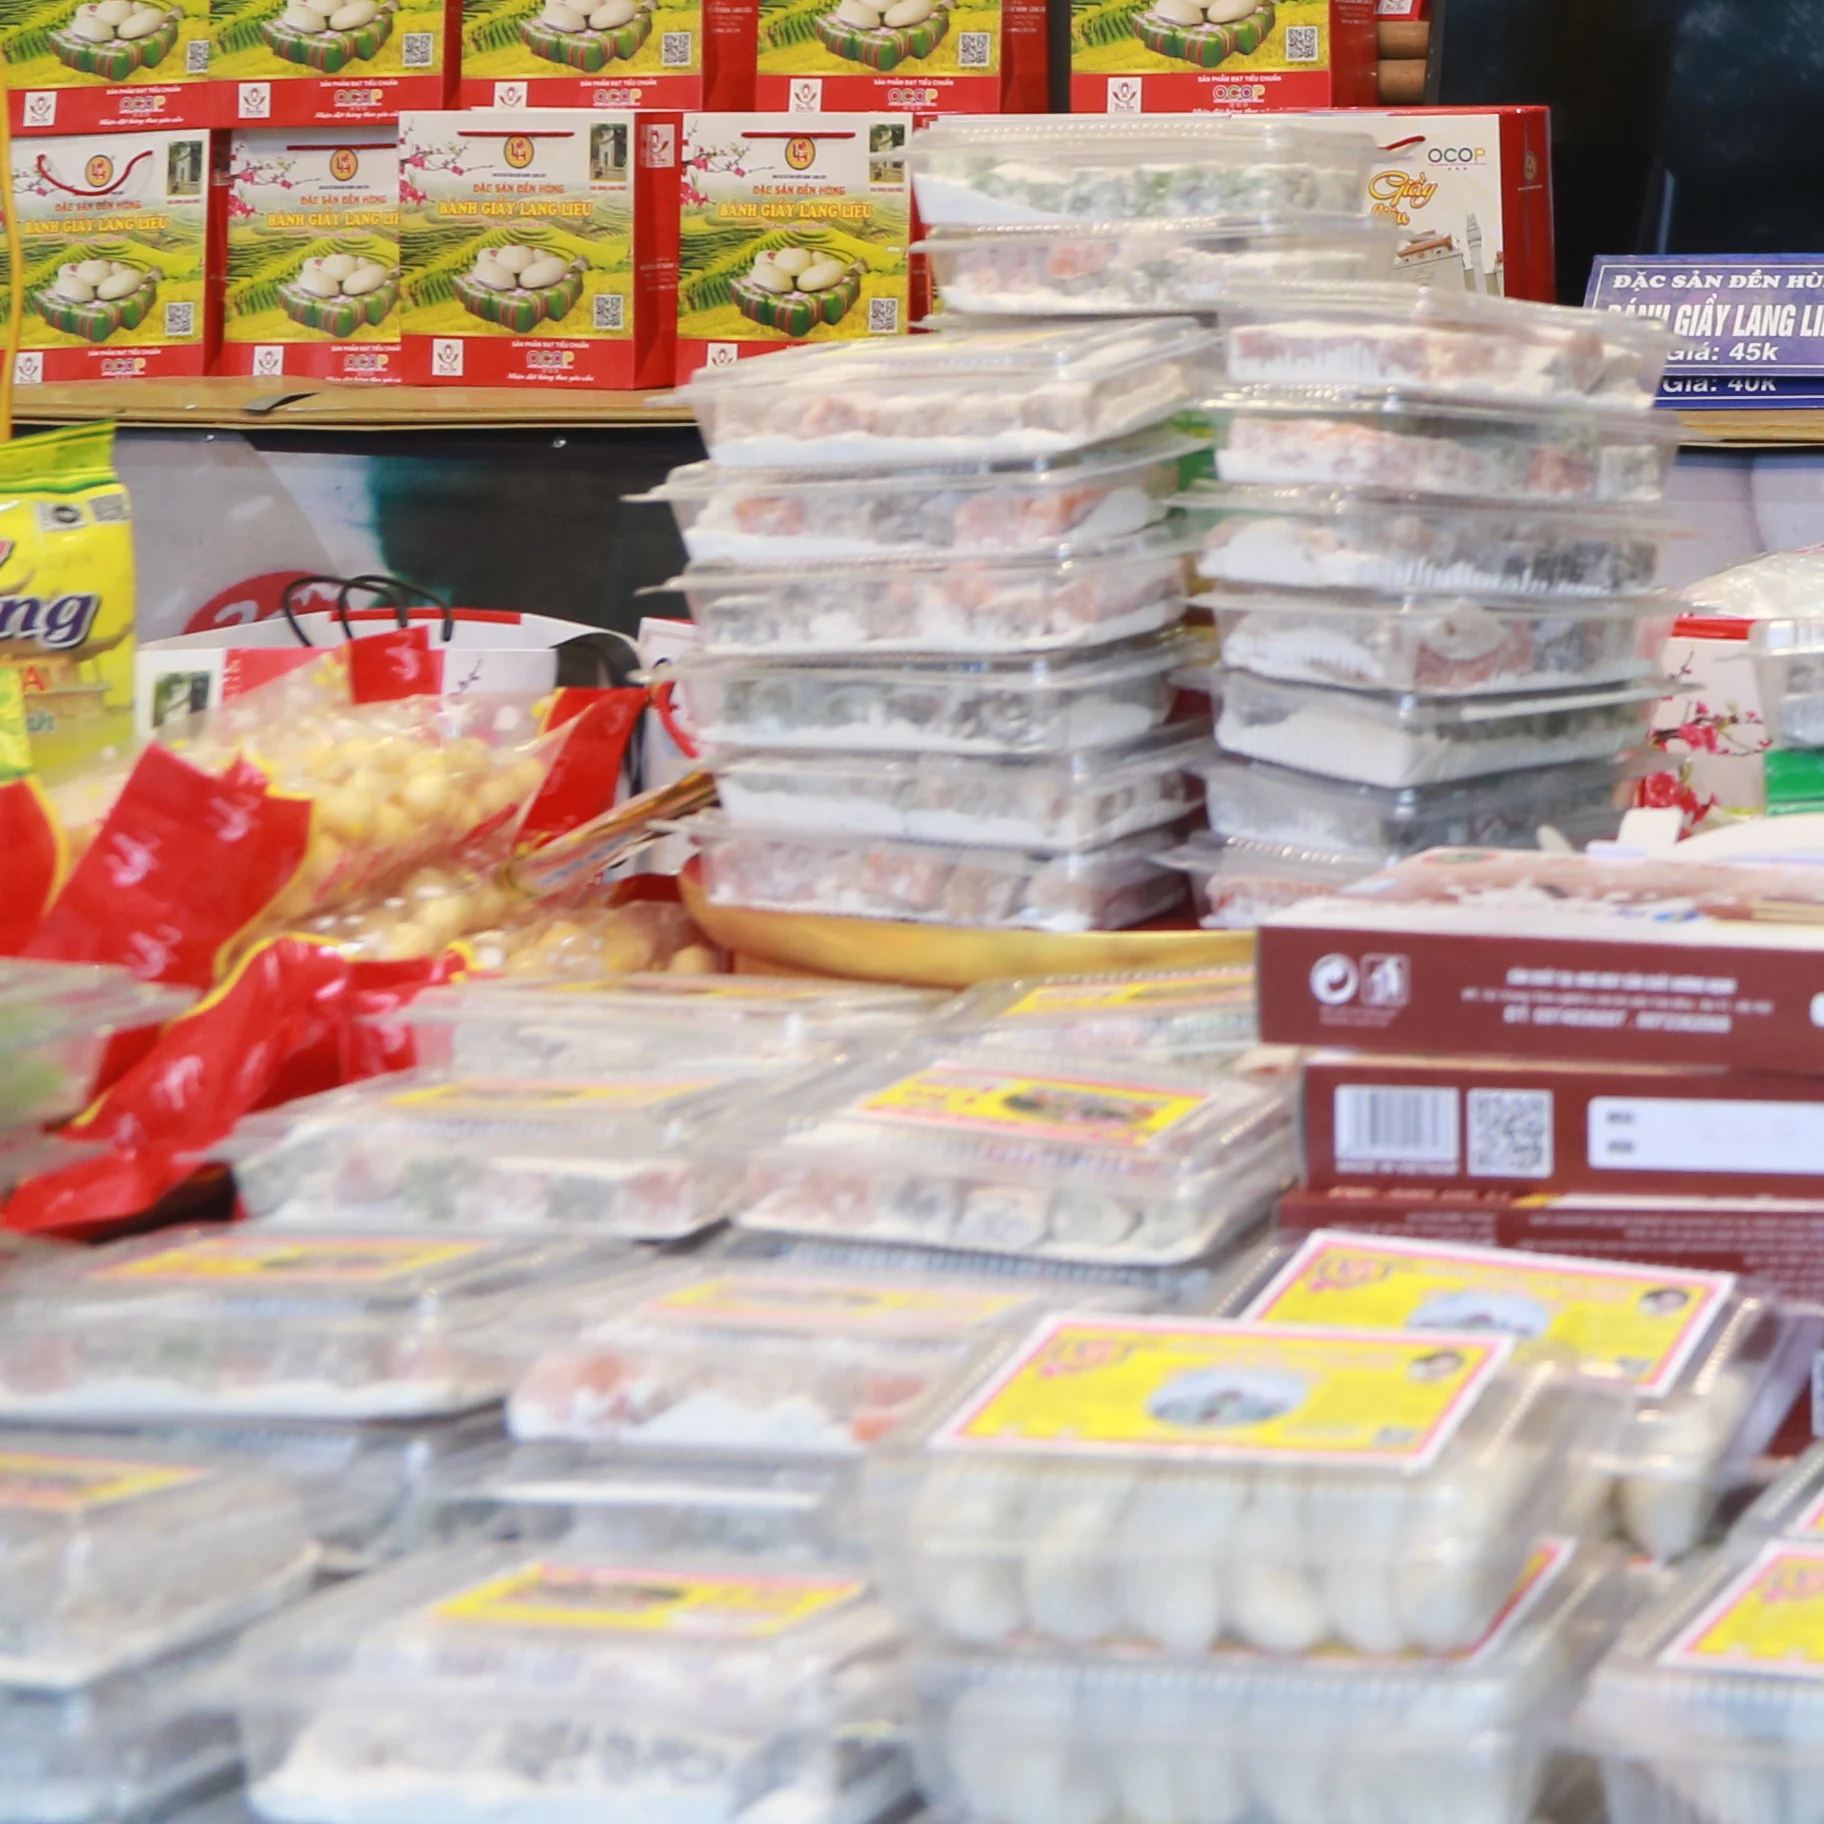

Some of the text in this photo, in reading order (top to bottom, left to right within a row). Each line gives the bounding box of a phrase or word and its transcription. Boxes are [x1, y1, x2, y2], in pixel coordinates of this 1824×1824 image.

[1213, 84, 1265, 100] OCOP
[1428, 147, 1486, 163] OCOP
[1612, 272, 1665, 291] ĐẶC
[1671, 270, 1722, 288] SẢN
[1728, 267, 1782, 288] ĐỀN
[1674, 294, 1731, 337] GIẦY
[1732, 305, 1797, 337] LANG
[1728, 342, 1780, 361] 45k
